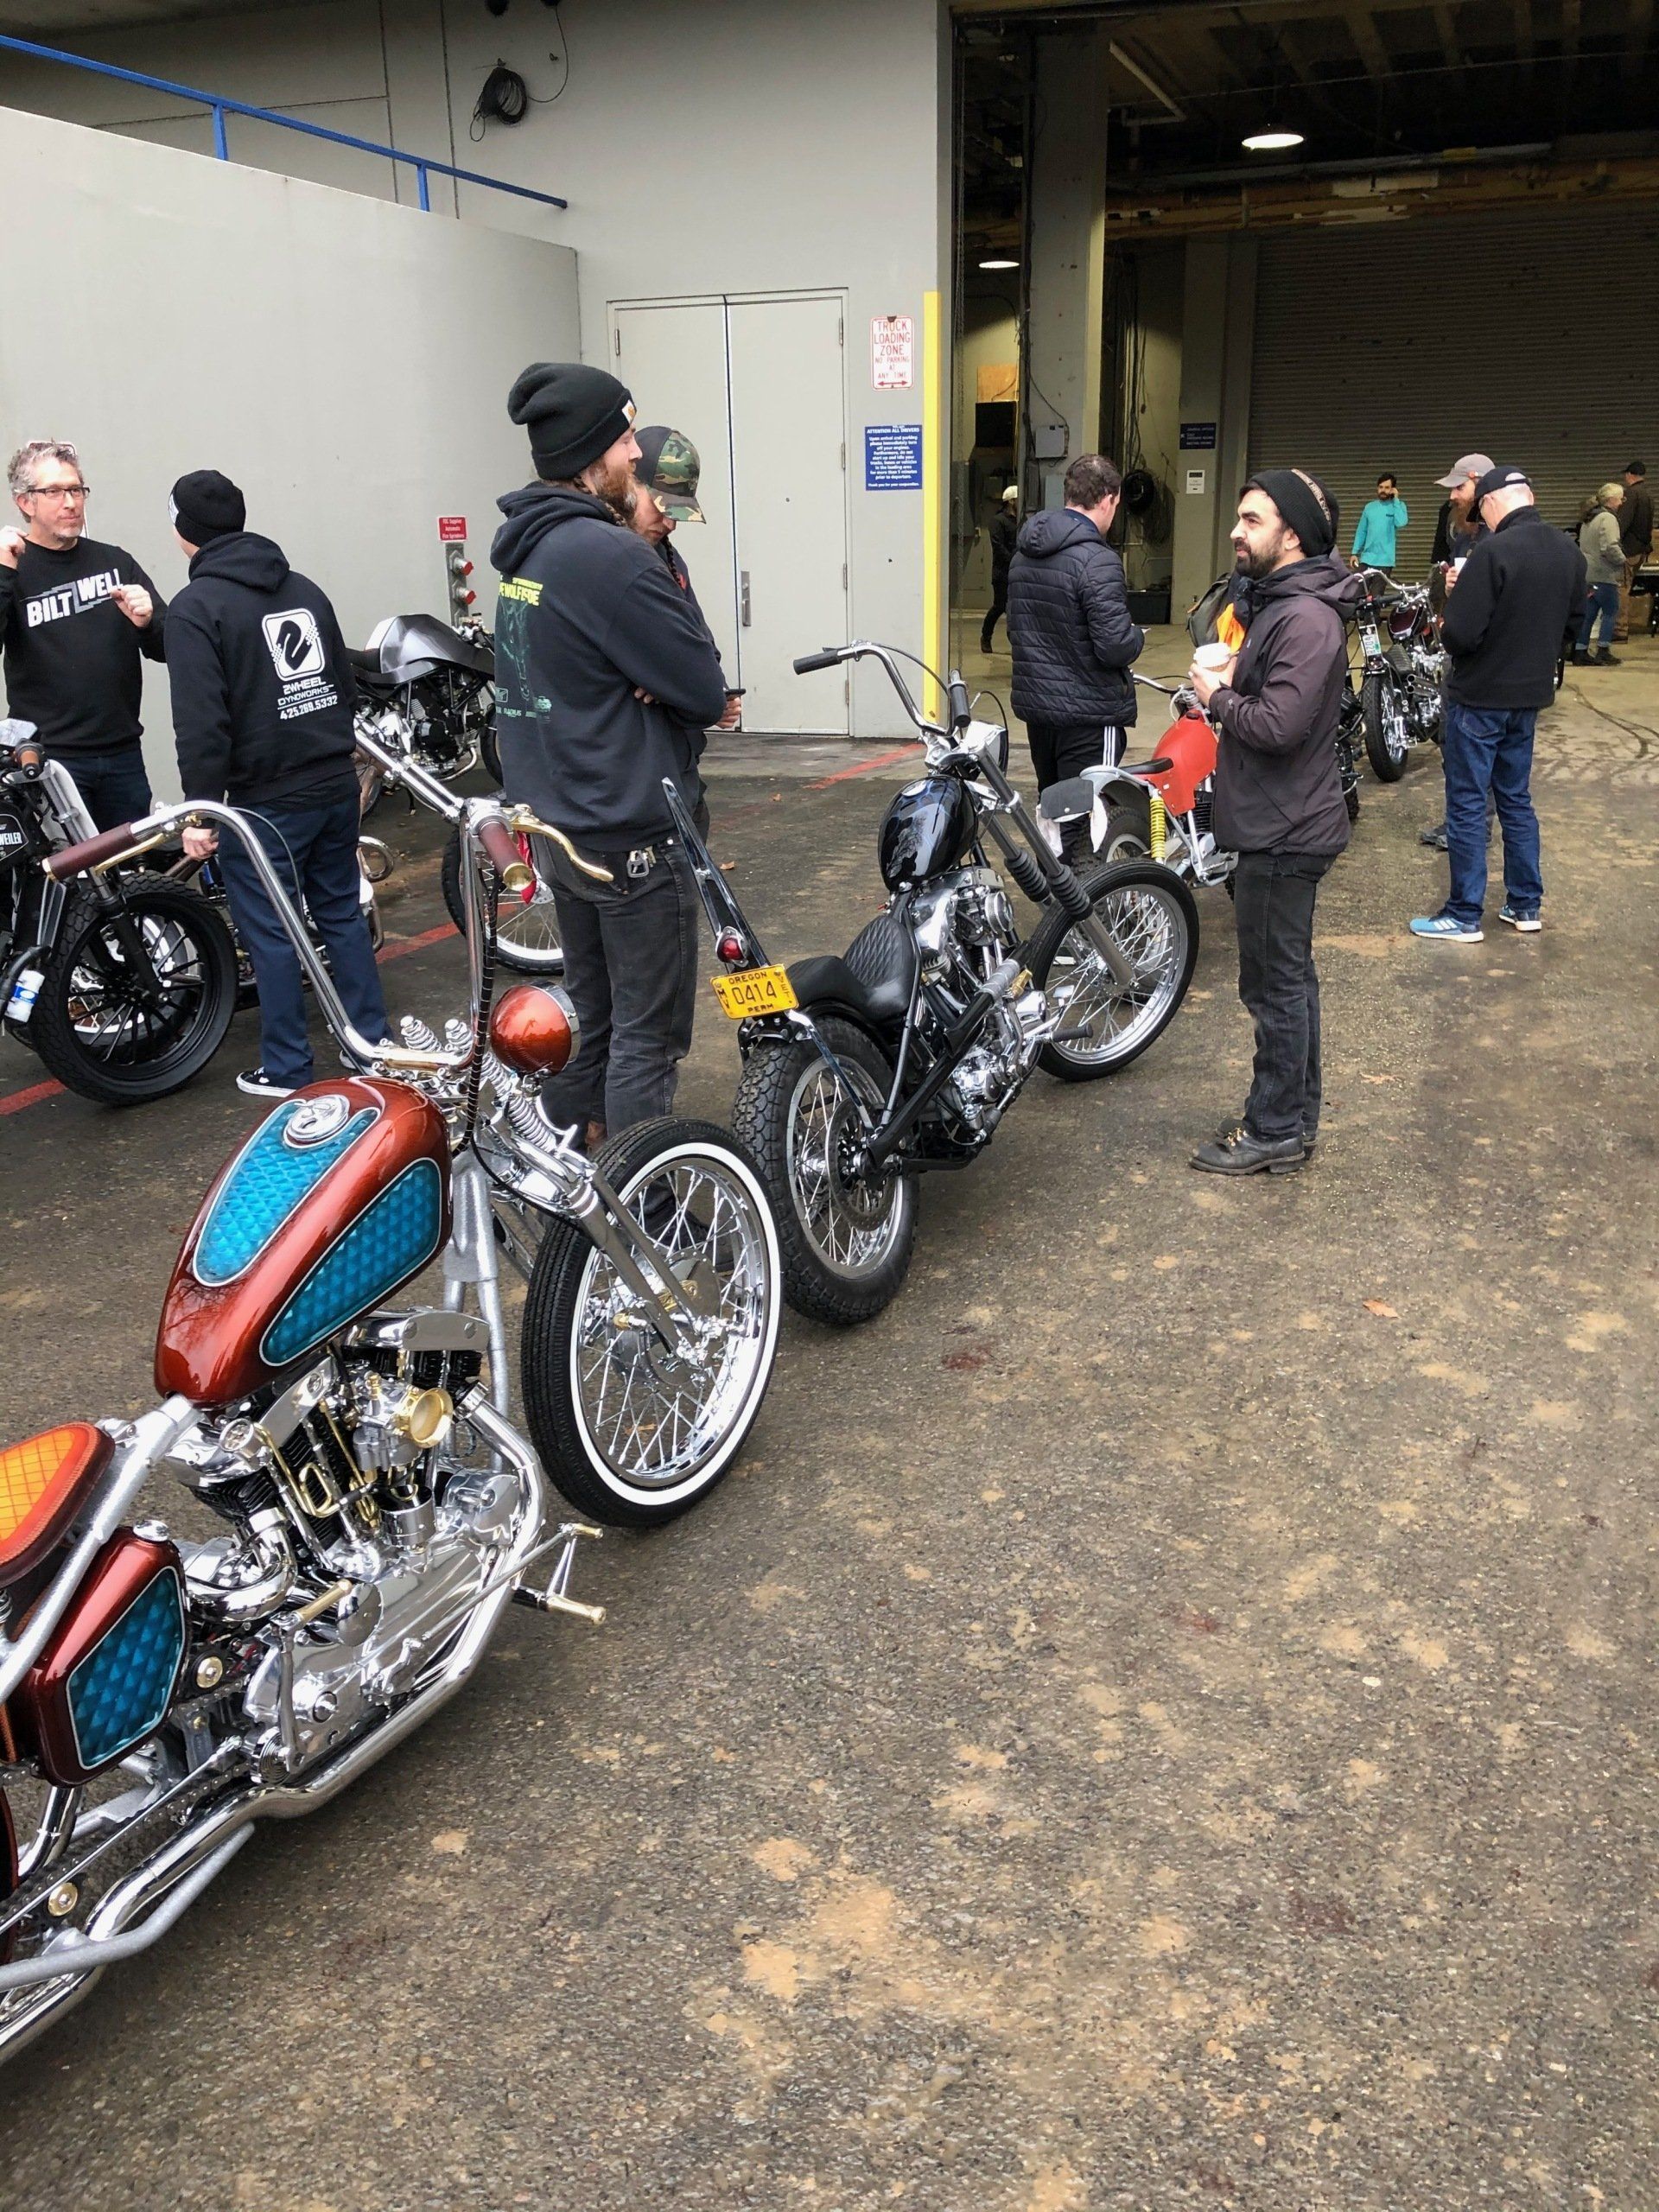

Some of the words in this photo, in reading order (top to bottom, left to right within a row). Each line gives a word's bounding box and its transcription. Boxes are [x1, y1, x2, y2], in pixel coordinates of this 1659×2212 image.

[878, 320, 907, 332] TRUCK
[874, 332, 911, 344] LOADING
[880, 344, 904, 356] ZONE
[26, 591, 73, 628] BILT
[282, 676, 327, 696] 2WHEEL
[277, 684, 334, 706] DYNOWORKS
[280, 695, 338, 720] 425.269.5332
[728, 971, 767, 985] OREGON
[731, 980, 777, 1005] 0414
[747, 1002, 774, 1013] PERM
